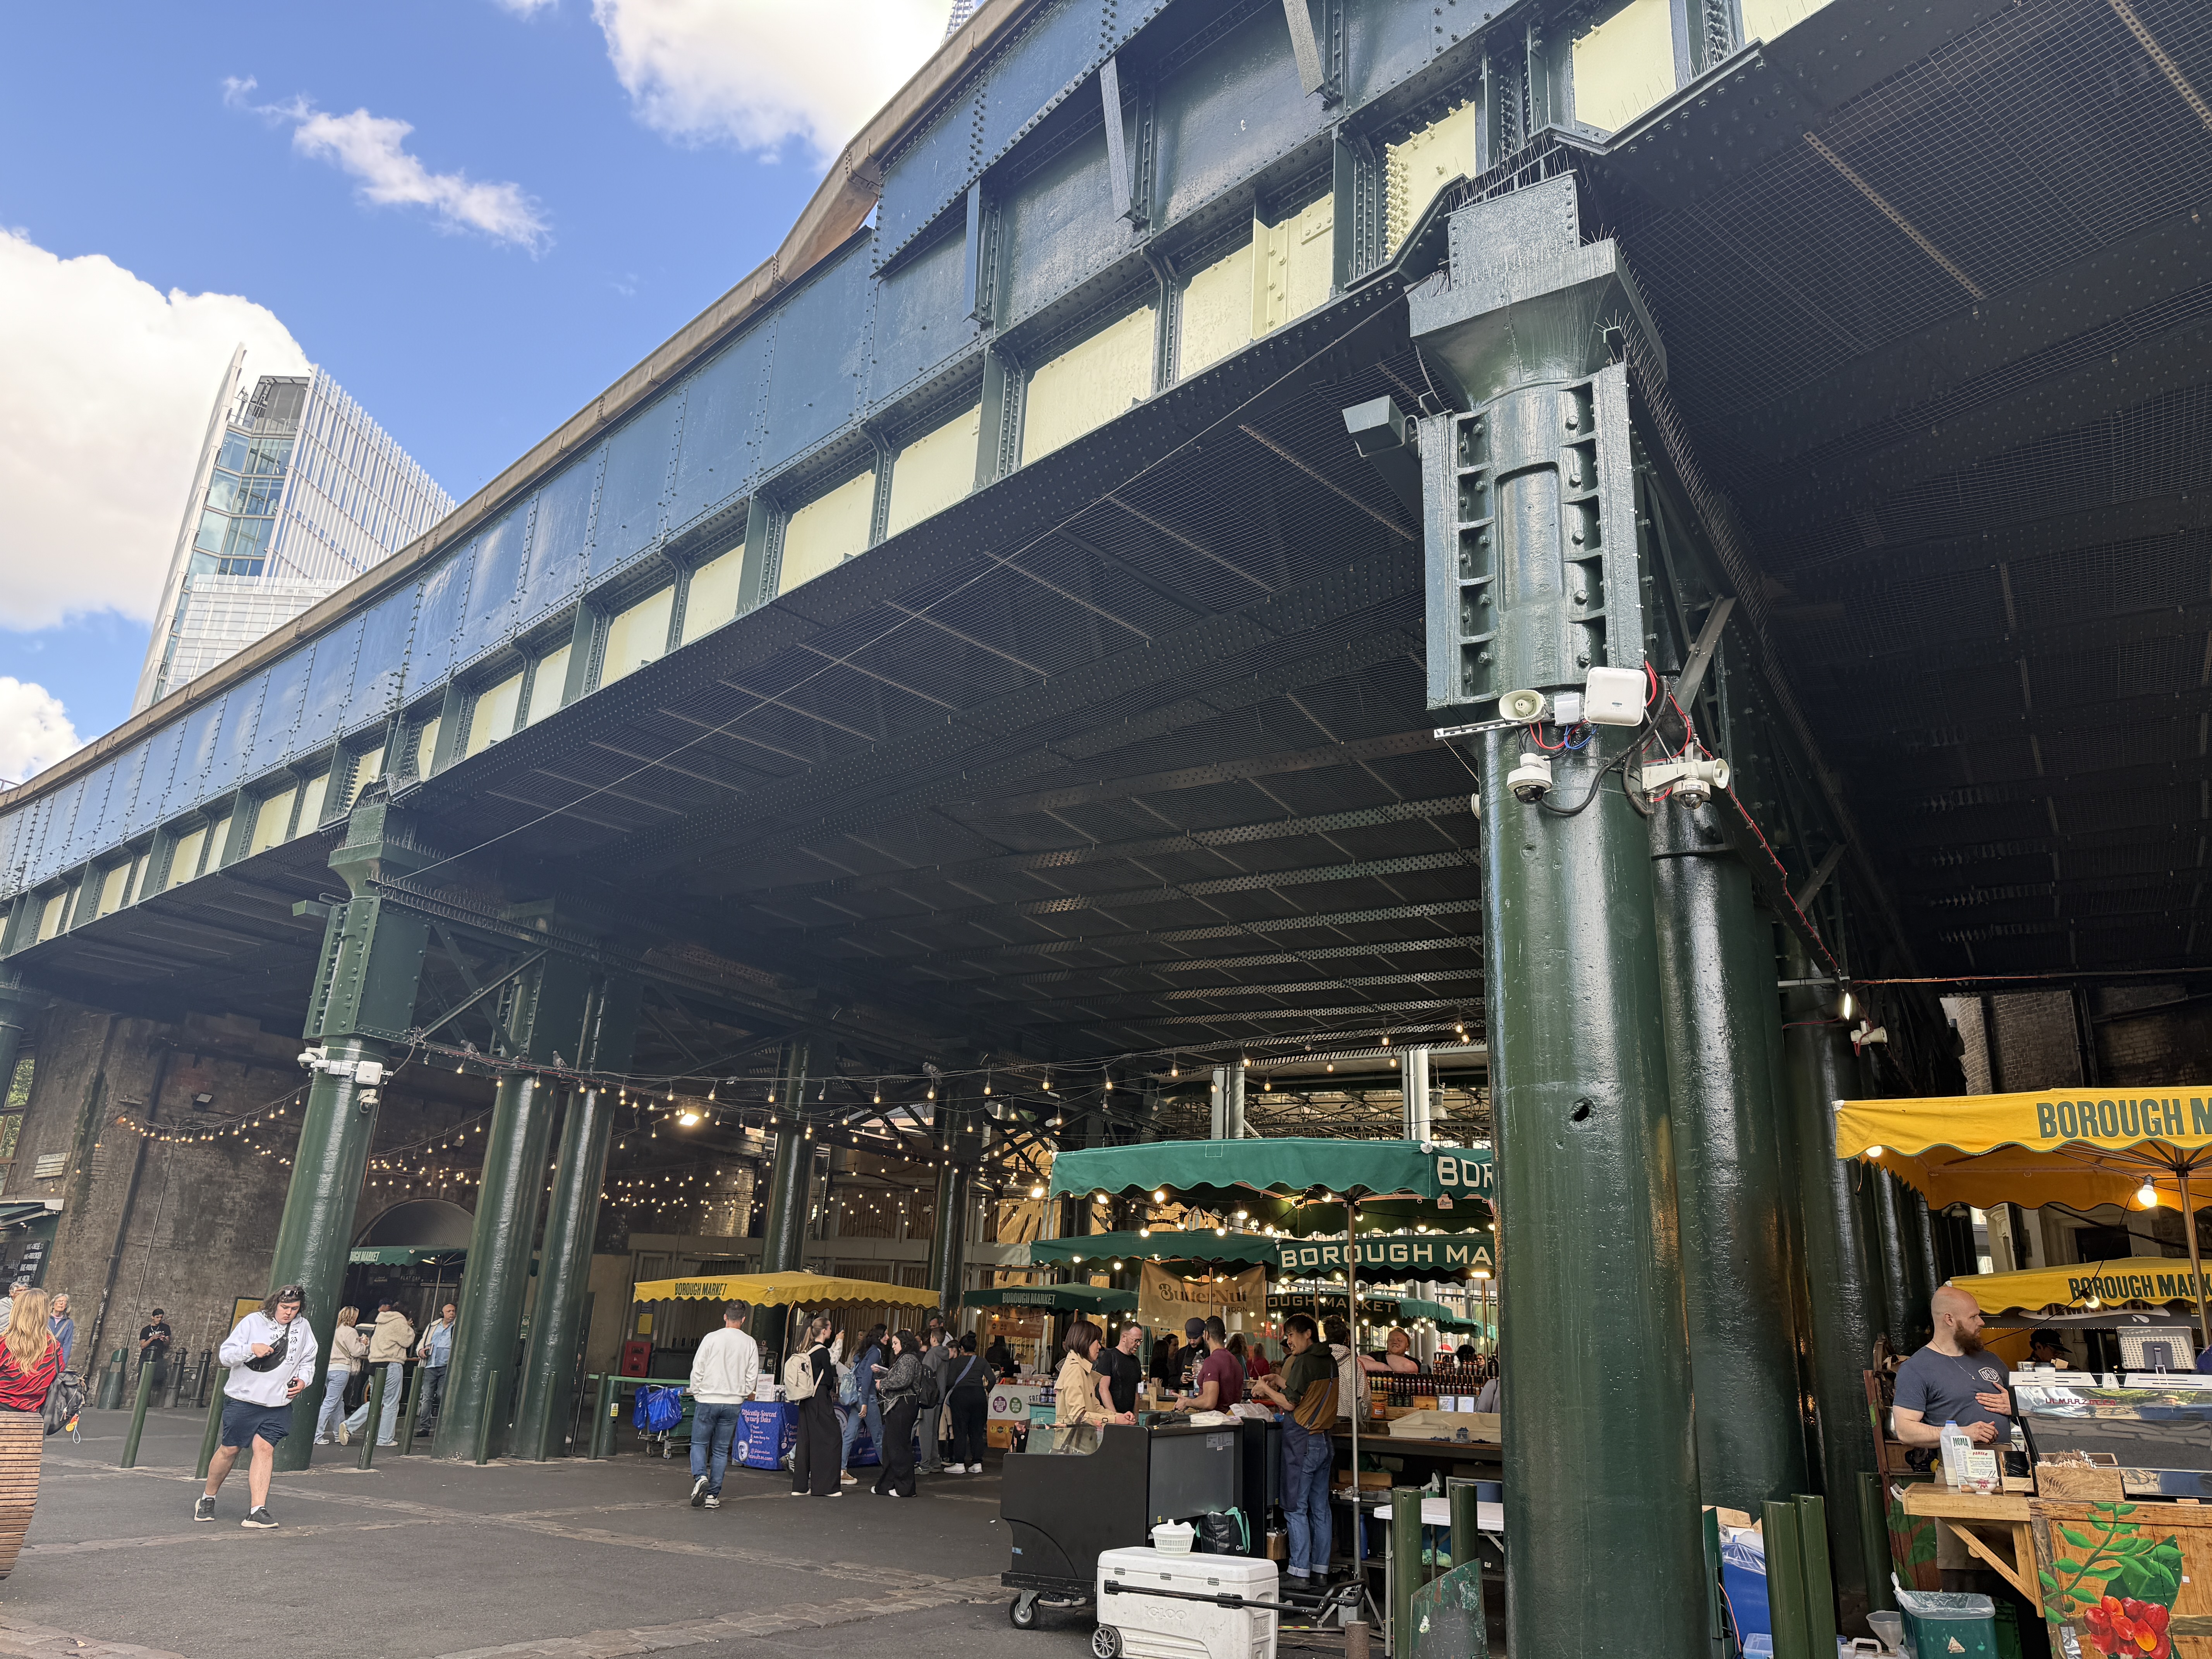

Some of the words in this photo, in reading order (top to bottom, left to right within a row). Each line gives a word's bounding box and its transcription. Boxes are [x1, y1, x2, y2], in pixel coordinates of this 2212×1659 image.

[2036, 1099, 2185, 1138] BOROUGH
[1437, 1156, 1493, 1188] BOR
[360, 1251, 380, 1262] MARKET
[1281, 1244, 1432, 1268] BOROUGH
[1447, 1245, 1492, 1266] MA
[675, 1283, 702, 1295] BOROUGH
[702, 1283, 728, 1296] MARKET
[1159, 1283, 1247, 1303] ButterNut
[2068, 1275, 2155, 1300] BOROUGH
[1002, 1293, 1030, 1304] BOROUGH
[1030, 1293, 1056, 1305] MARKET
[1953, 1437, 1969, 1447] MOMA
[1145, 1606, 1187, 1621] IGLOO
